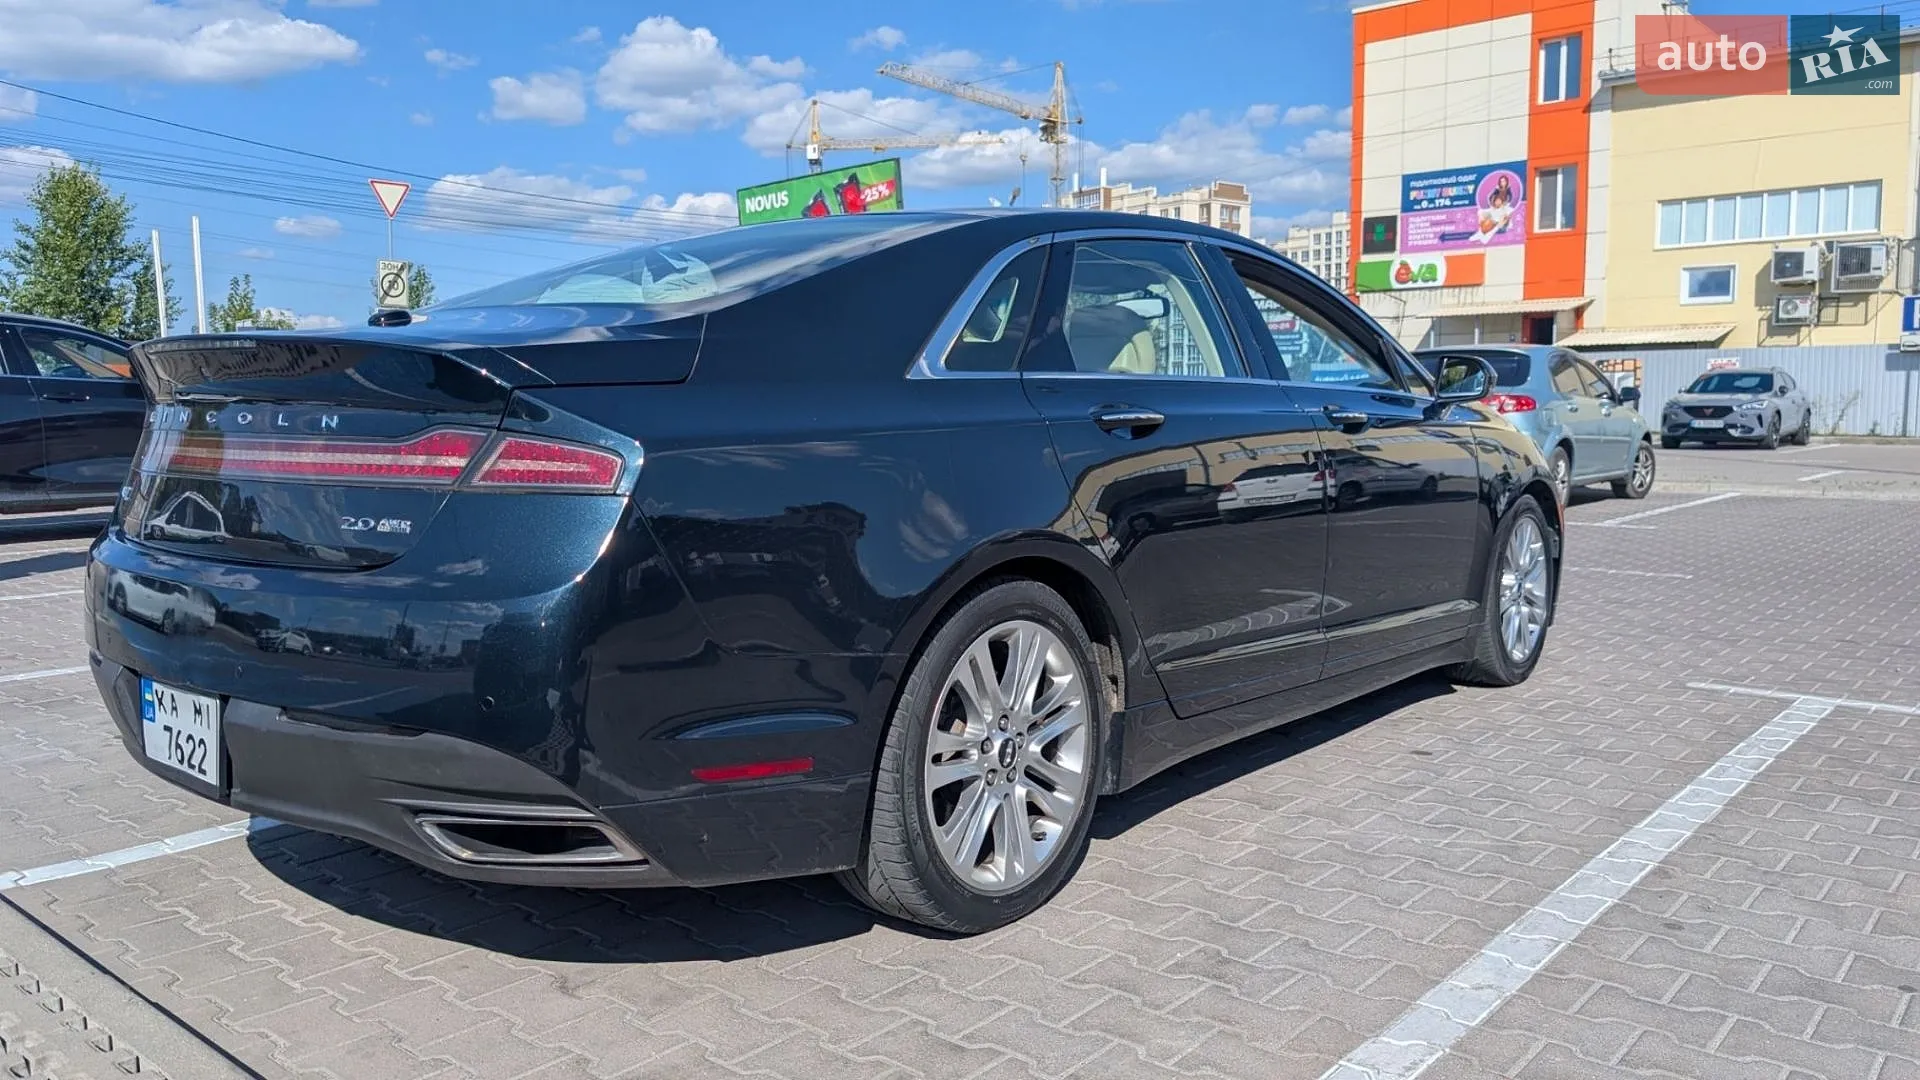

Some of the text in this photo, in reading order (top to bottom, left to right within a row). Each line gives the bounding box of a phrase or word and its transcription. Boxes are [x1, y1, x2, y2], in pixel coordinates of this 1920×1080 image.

[745, 190, 789, 213] NOVUS
[860, 183, 890, 202] -25%
[149, 410, 339, 430] LINCOLN
[155, 689, 179, 718] KA
[163, 725, 208, 776] 7622
